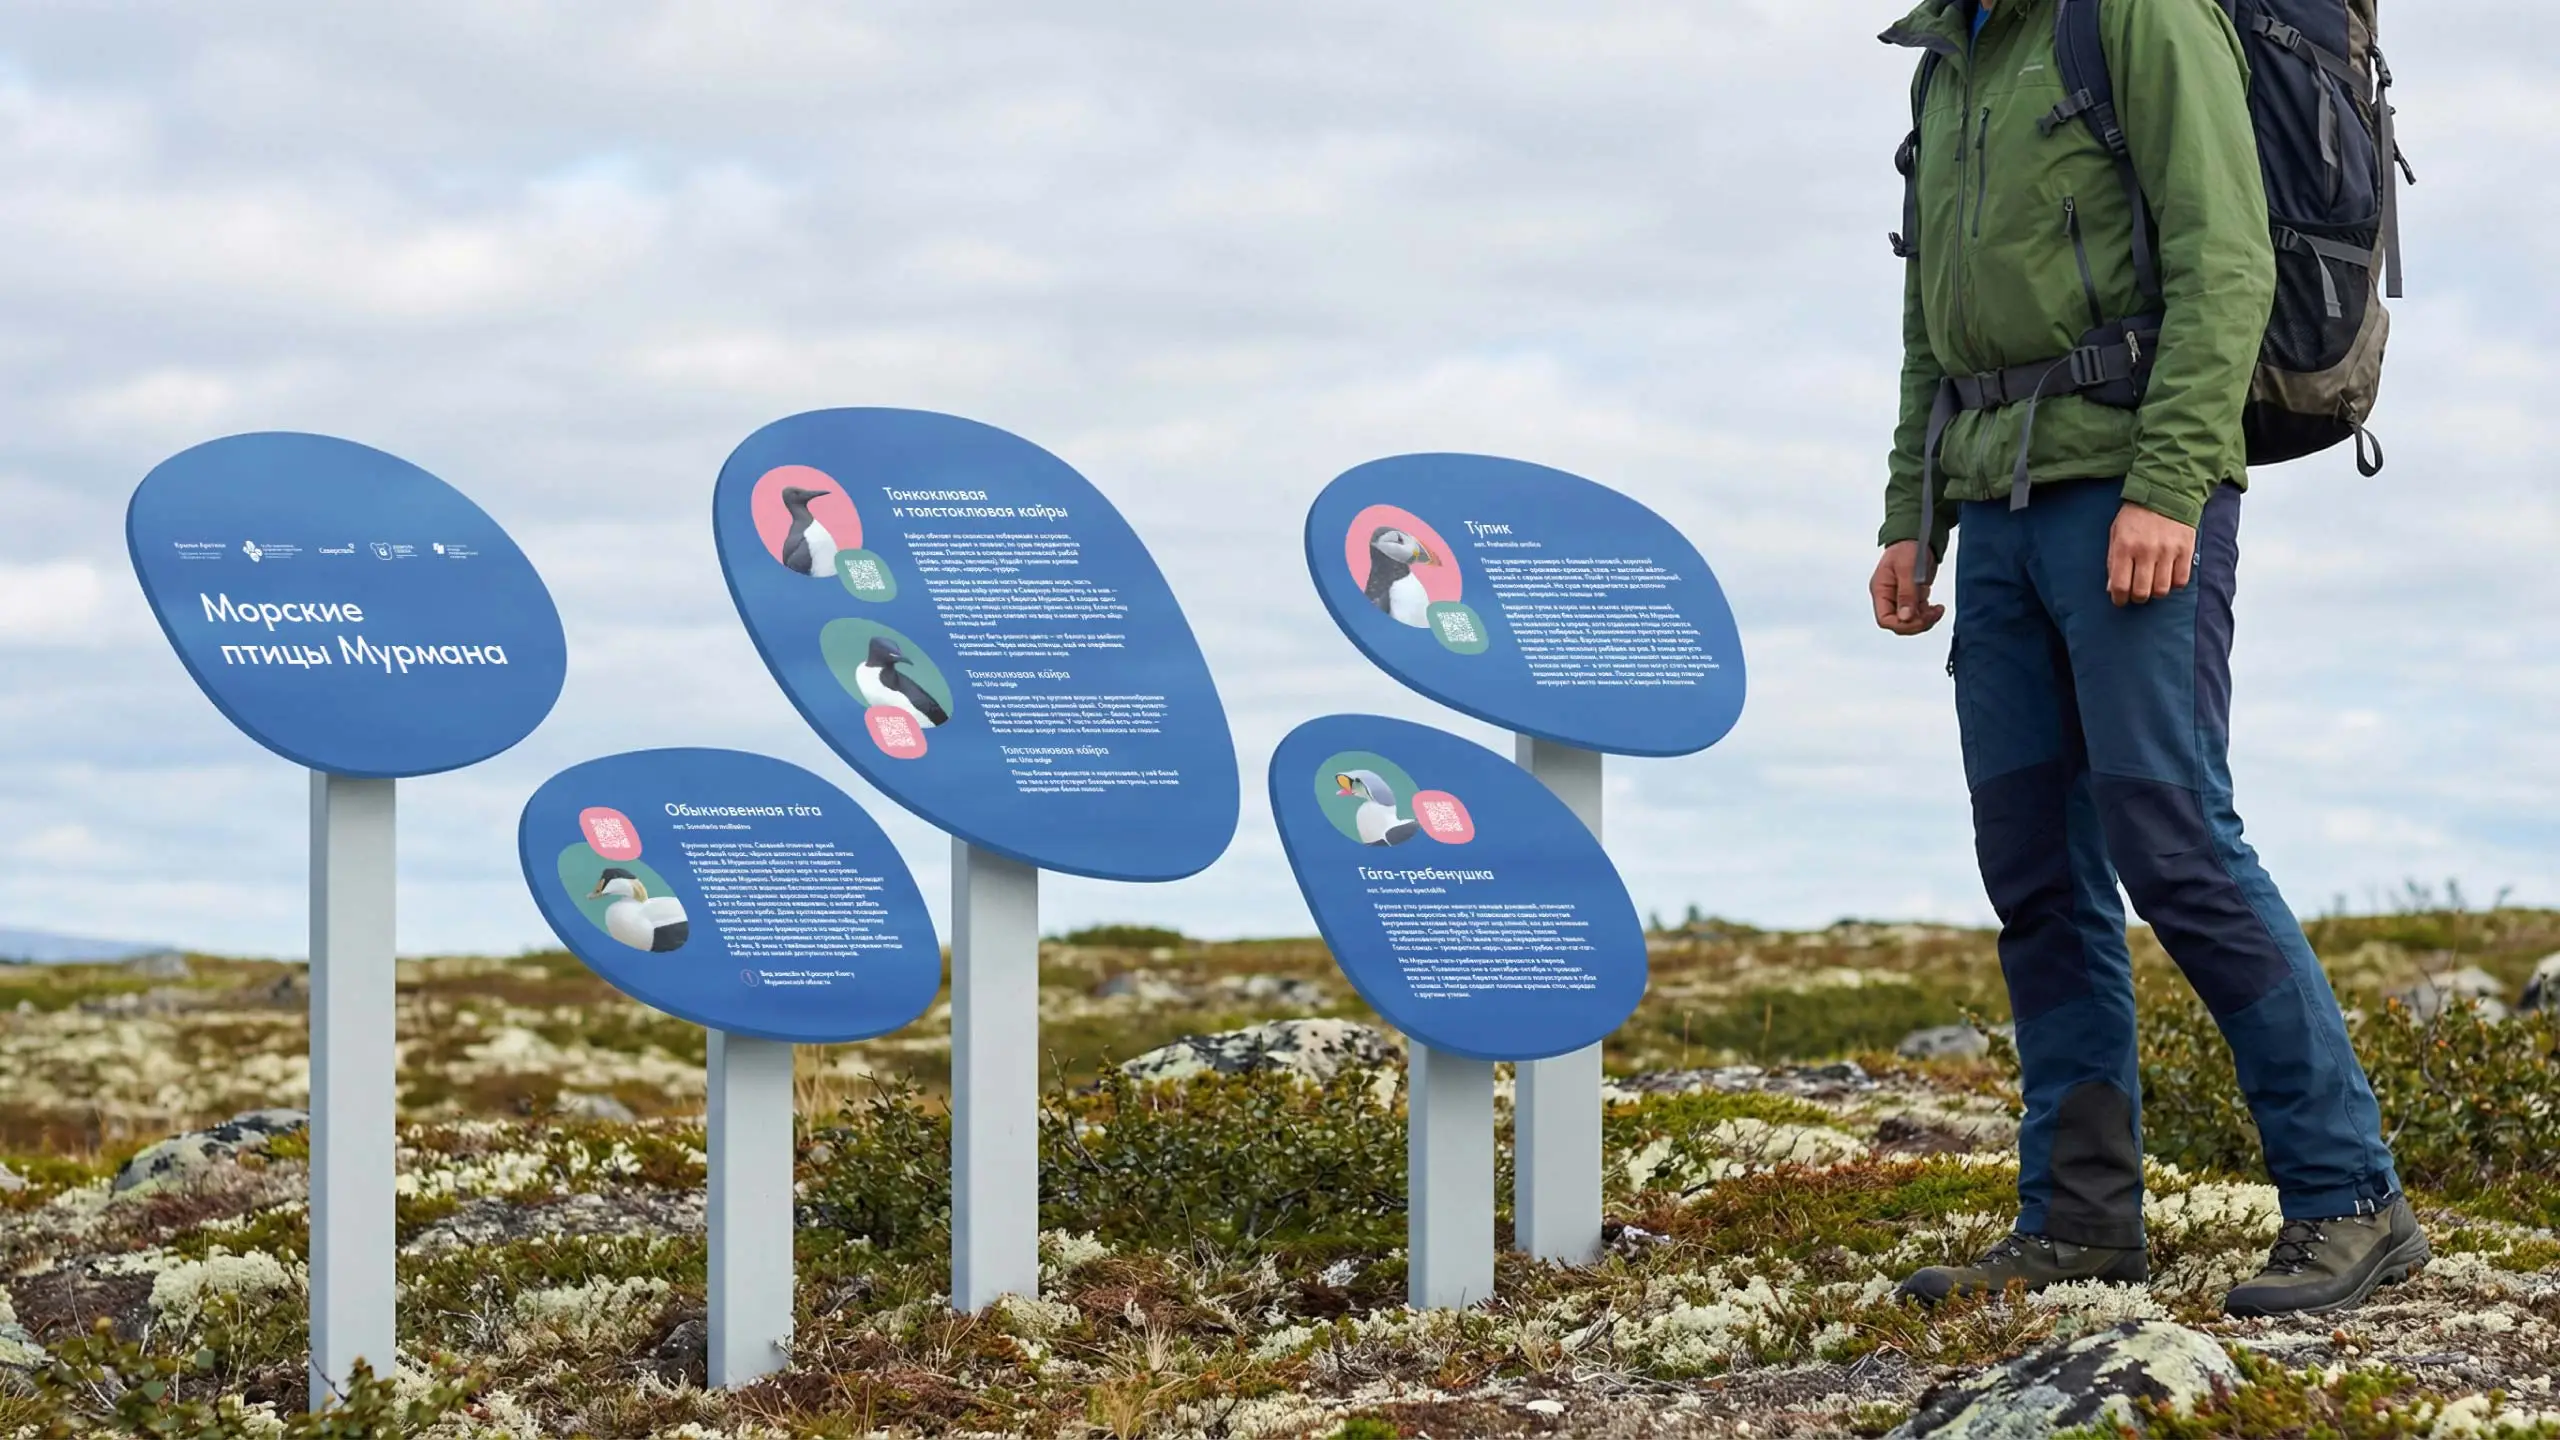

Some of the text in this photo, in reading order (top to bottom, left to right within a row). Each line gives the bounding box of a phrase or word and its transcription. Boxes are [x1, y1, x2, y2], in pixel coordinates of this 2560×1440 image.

[883, 486, 988, 501] Тонкоклювая
[892, 503, 1069, 522] и толстоклювая кайры
[200, 592, 365, 632] Морские
[220, 635, 508, 674] птицы Мурмана
[965, 669, 1036, 679] Тонкоклювая
[1000, 745, 1075, 755] Толстоклювая
[664, 802, 785, 817] Обыкновенная
